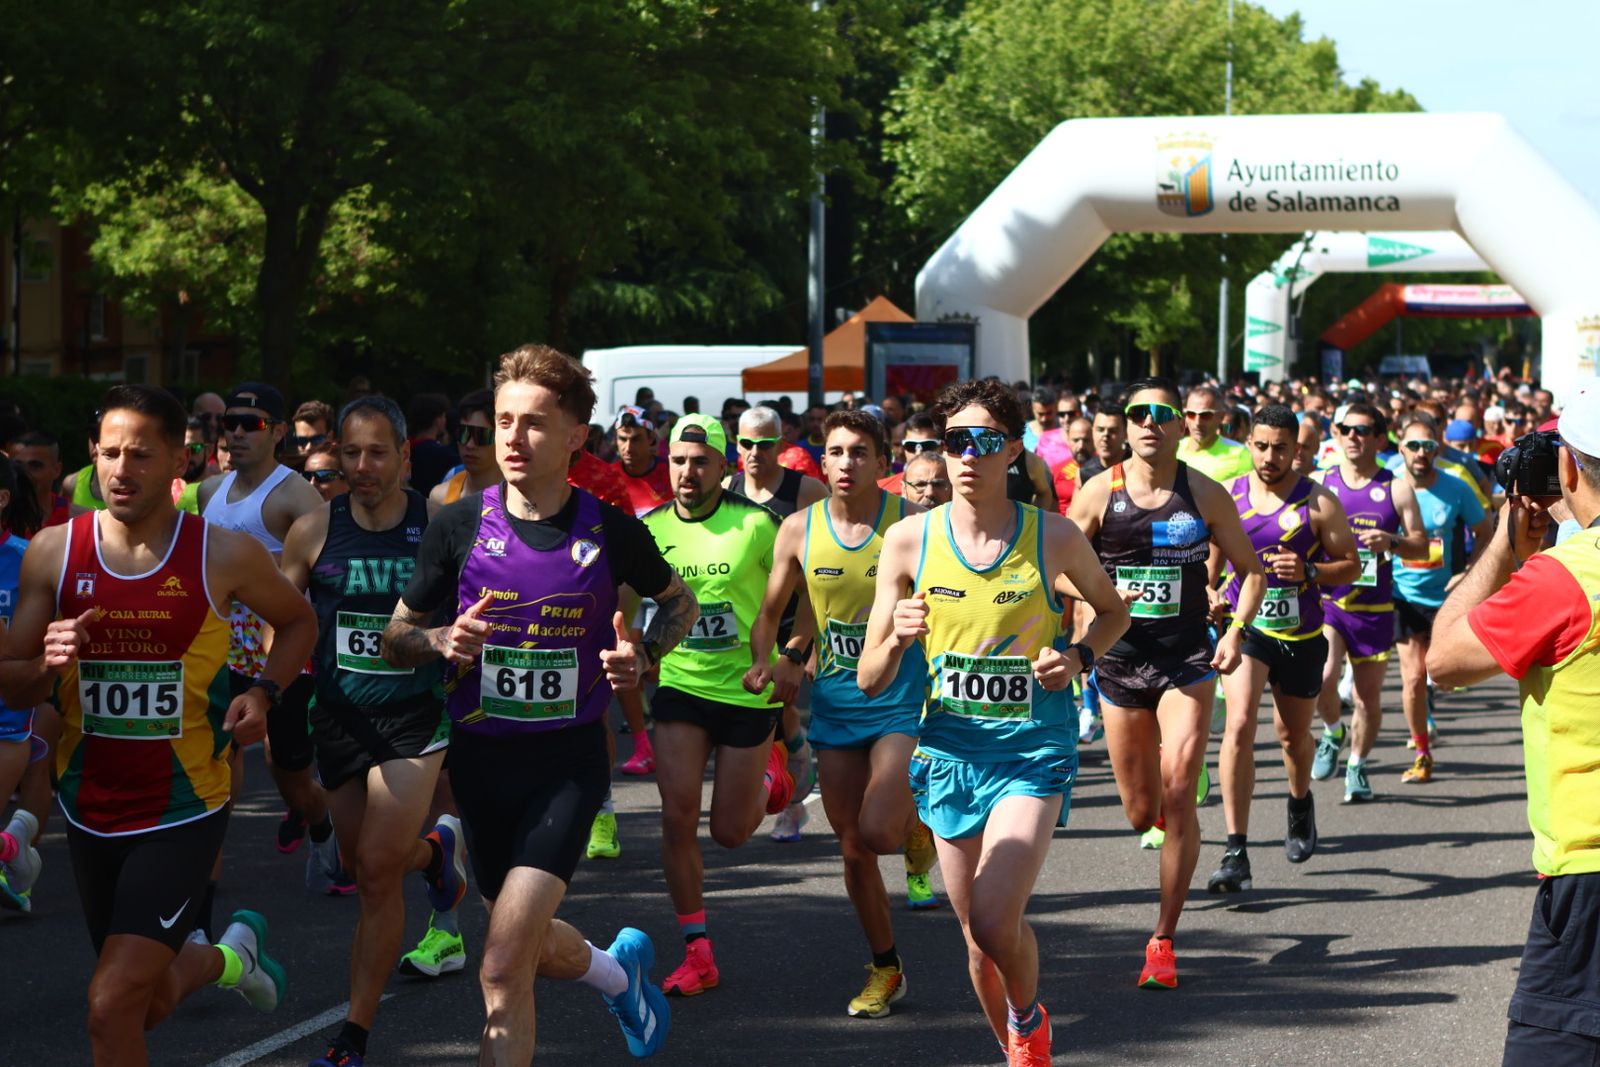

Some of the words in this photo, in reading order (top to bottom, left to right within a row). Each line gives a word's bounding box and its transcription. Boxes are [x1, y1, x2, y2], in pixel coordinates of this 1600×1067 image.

[1227, 158, 1399, 188] Ayuntamiento
[1228, 190, 1257, 212] de
[1266, 190, 1401, 212] Salamanca
[344, 556, 416, 597] AVS
[109, 610, 135, 620] CAJA
[138, 610, 172, 620] RURAL
[540, 604, 584, 619] PRIM
[1254, 600, 1290, 618] 20
[104, 628, 152, 640] VINO
[358, 621, 385, 631] CARRE
[489, 622, 522, 633] tletismo
[527, 622, 586, 637] Macotera
[687, 615, 727, 637] 12
[90, 642, 113, 654] DE
[116, 641, 167, 655] TORO
[348, 630, 382, 657] 63
[507, 657, 551, 667] CARRERA
[945, 654, 966, 669] XIV
[107, 671, 155, 680] CARRERA
[496, 667, 562, 701] 618
[947, 671, 1028, 703] 1008
[85, 683, 178, 717] 1015
